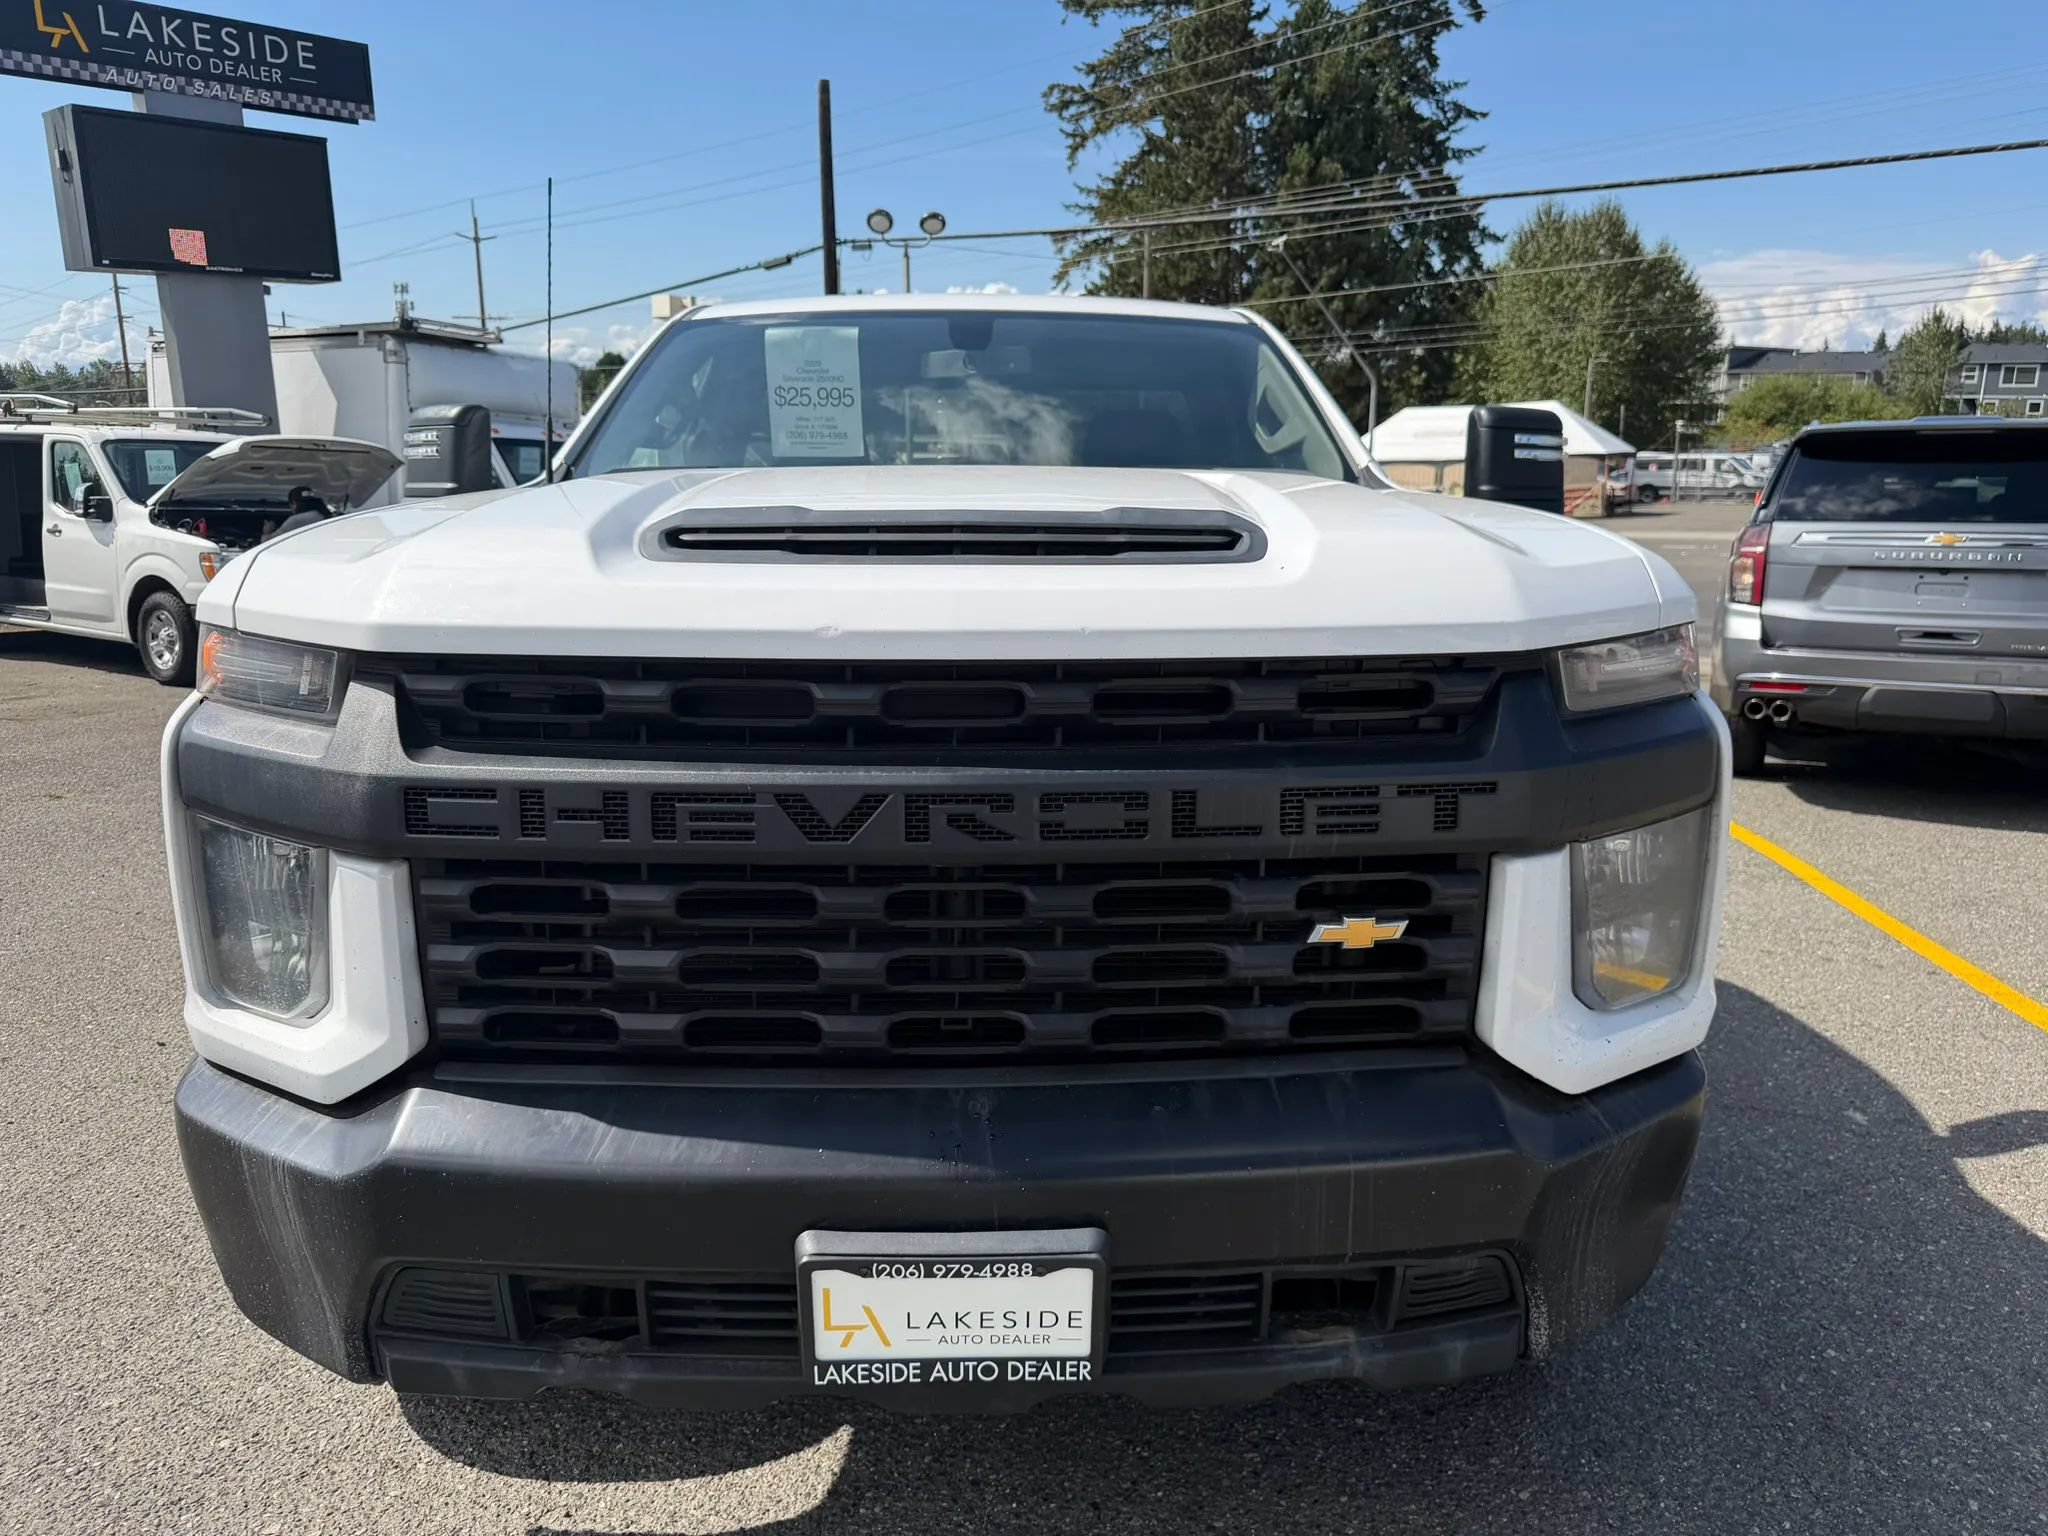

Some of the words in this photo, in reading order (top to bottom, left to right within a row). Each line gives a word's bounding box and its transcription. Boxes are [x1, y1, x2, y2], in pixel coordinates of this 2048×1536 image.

[98, 5, 316, 70] LAKESIDE
[145, 48, 202, 71] AUTO
[210, 57, 282, 84] DEALER
[105, 69, 177, 91] AUTO
[193, 82, 272, 105] SALES
[774, 385, 855, 410] $25,995
[404, 783, 1498, 844] CHEVROLET
[872, 1263, 925, 1279] (206)
[933, 1263, 1033, 1279] 979-4988
[906, 1310, 1084, 1330] LAKESIDE
[938, 1334, 983, 1345] AUTO
[990, 1334, 1051, 1345] DEALER
[813, 1363, 921, 1386] LAKESIDE
[929, 1361, 999, 1382] AUTO
[1007, 1361, 1092, 1381] DEALER
